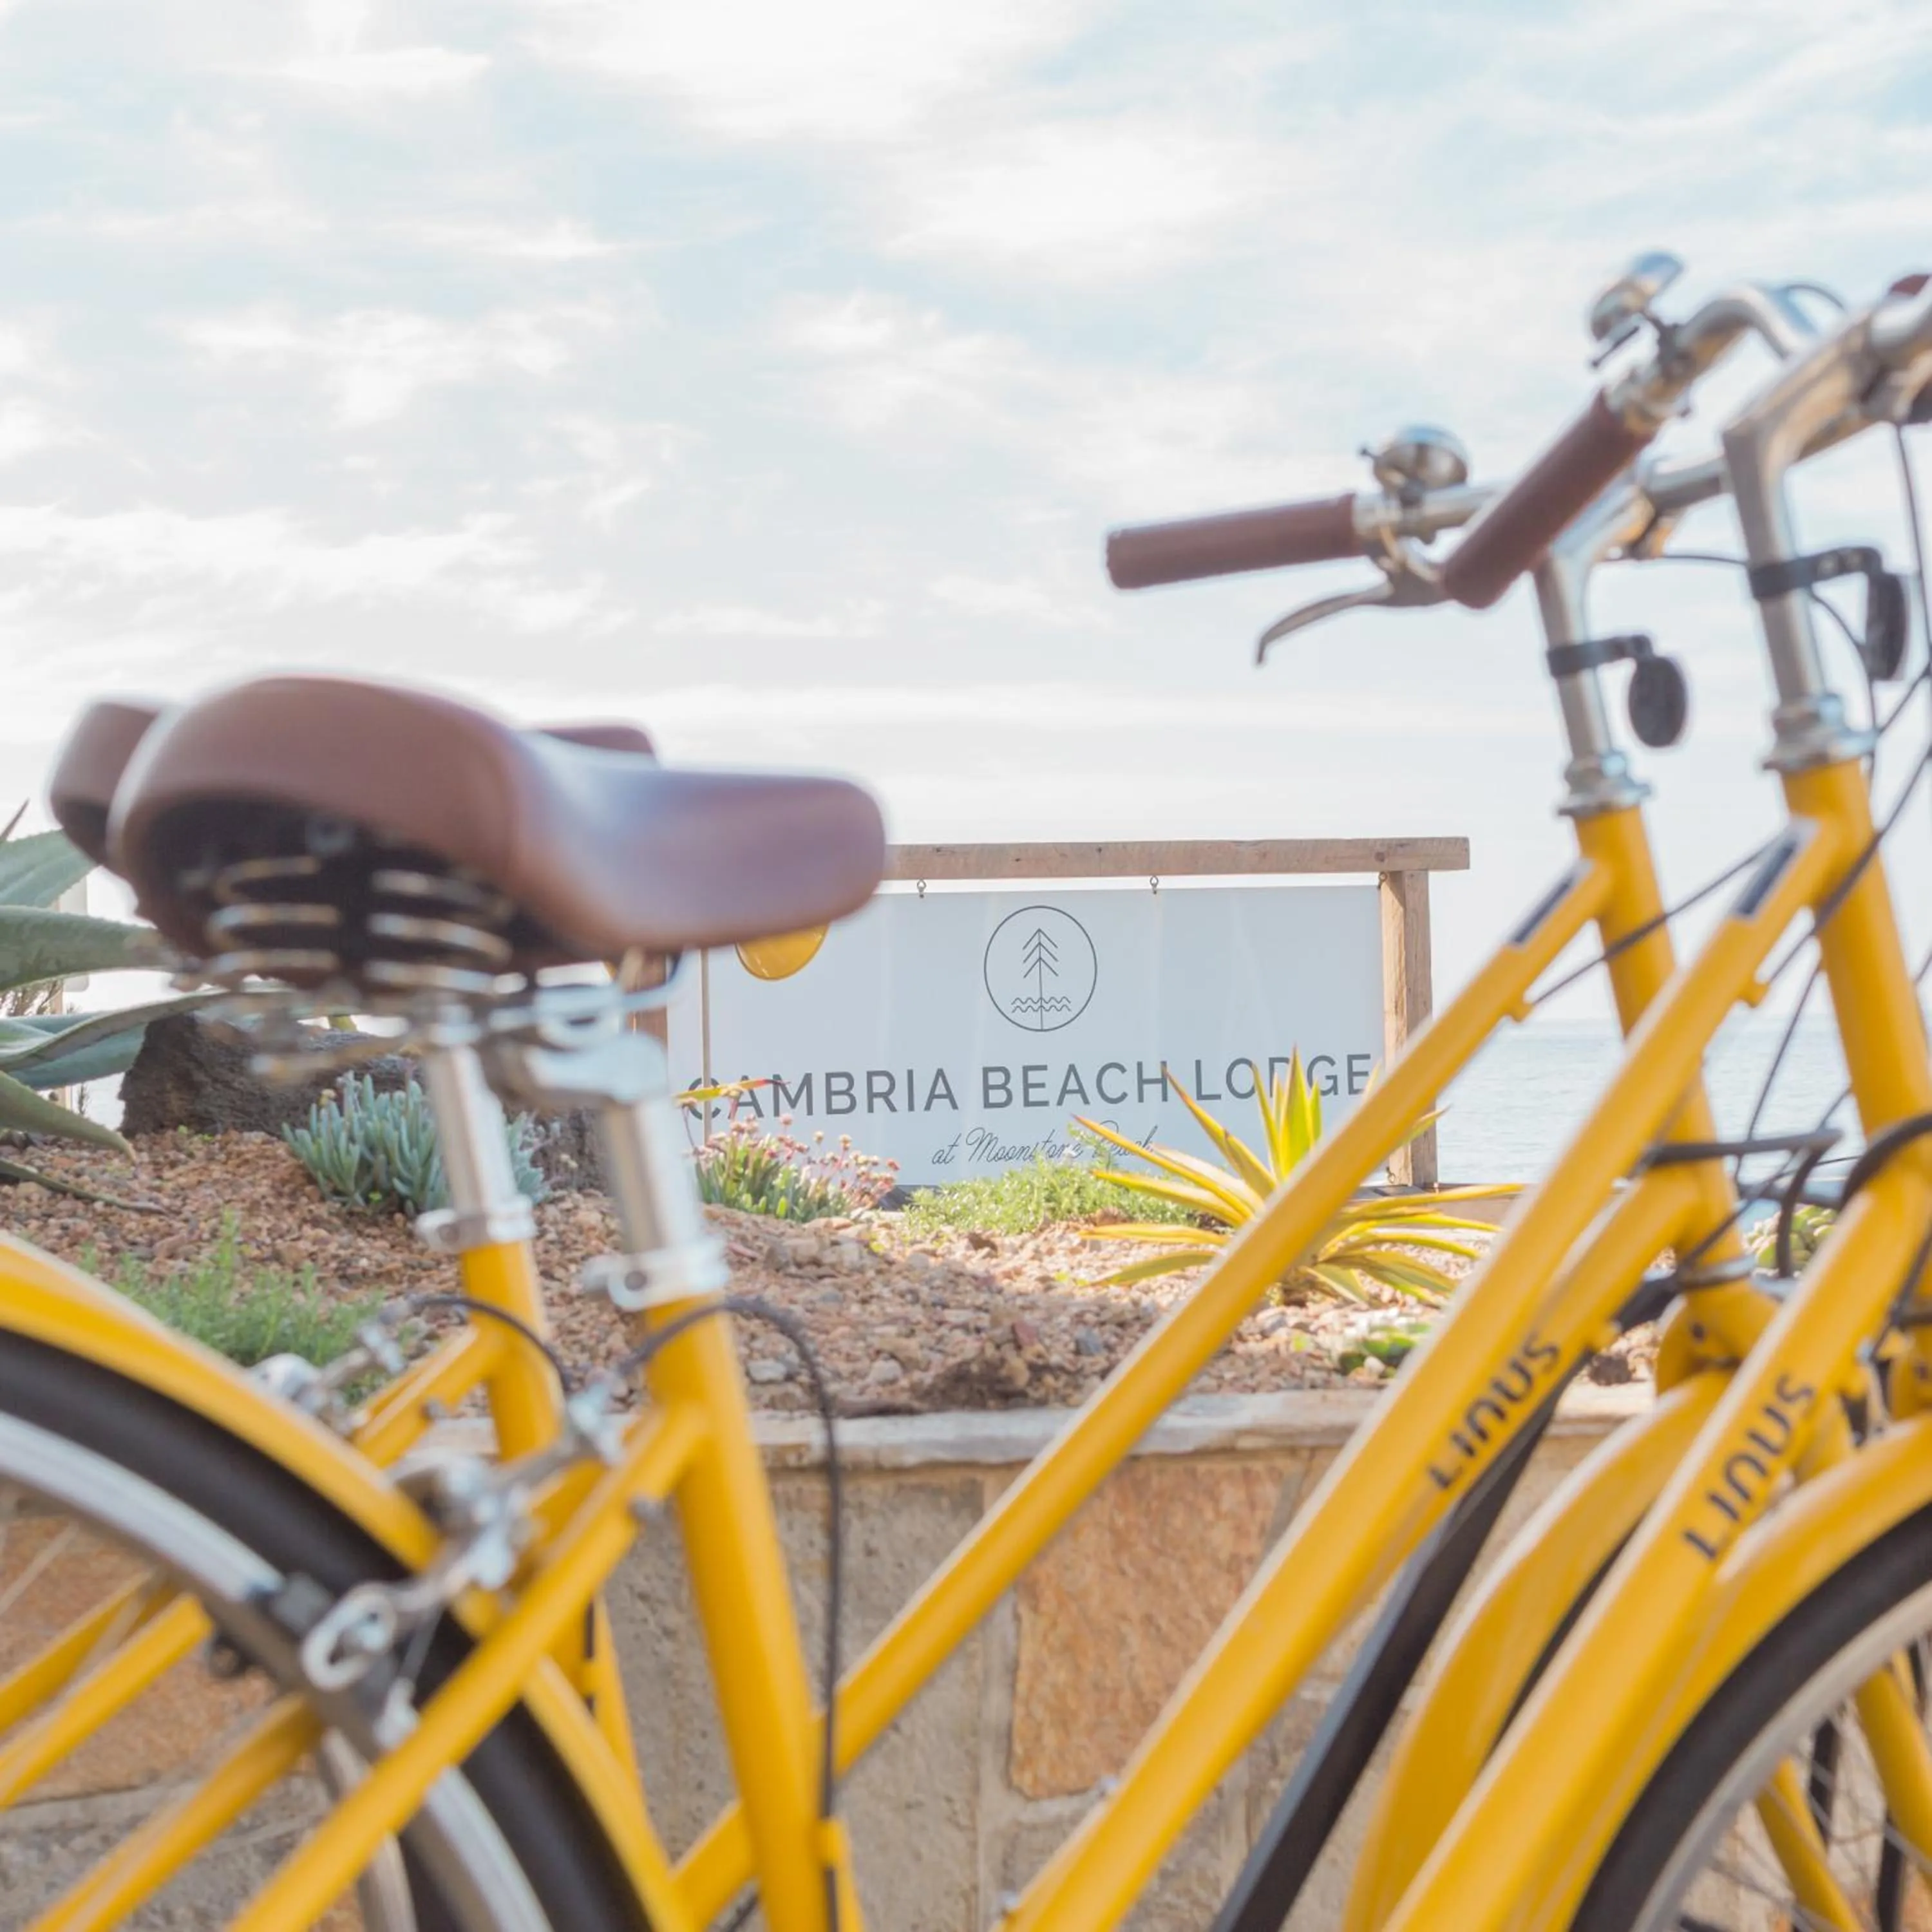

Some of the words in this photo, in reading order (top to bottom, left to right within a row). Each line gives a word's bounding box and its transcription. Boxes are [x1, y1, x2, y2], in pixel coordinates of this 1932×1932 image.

[687, 1068, 958, 1121] CAMBRIA
[982, 1061, 1168, 1109] BEACH
[932, 1132, 961, 1164] at
